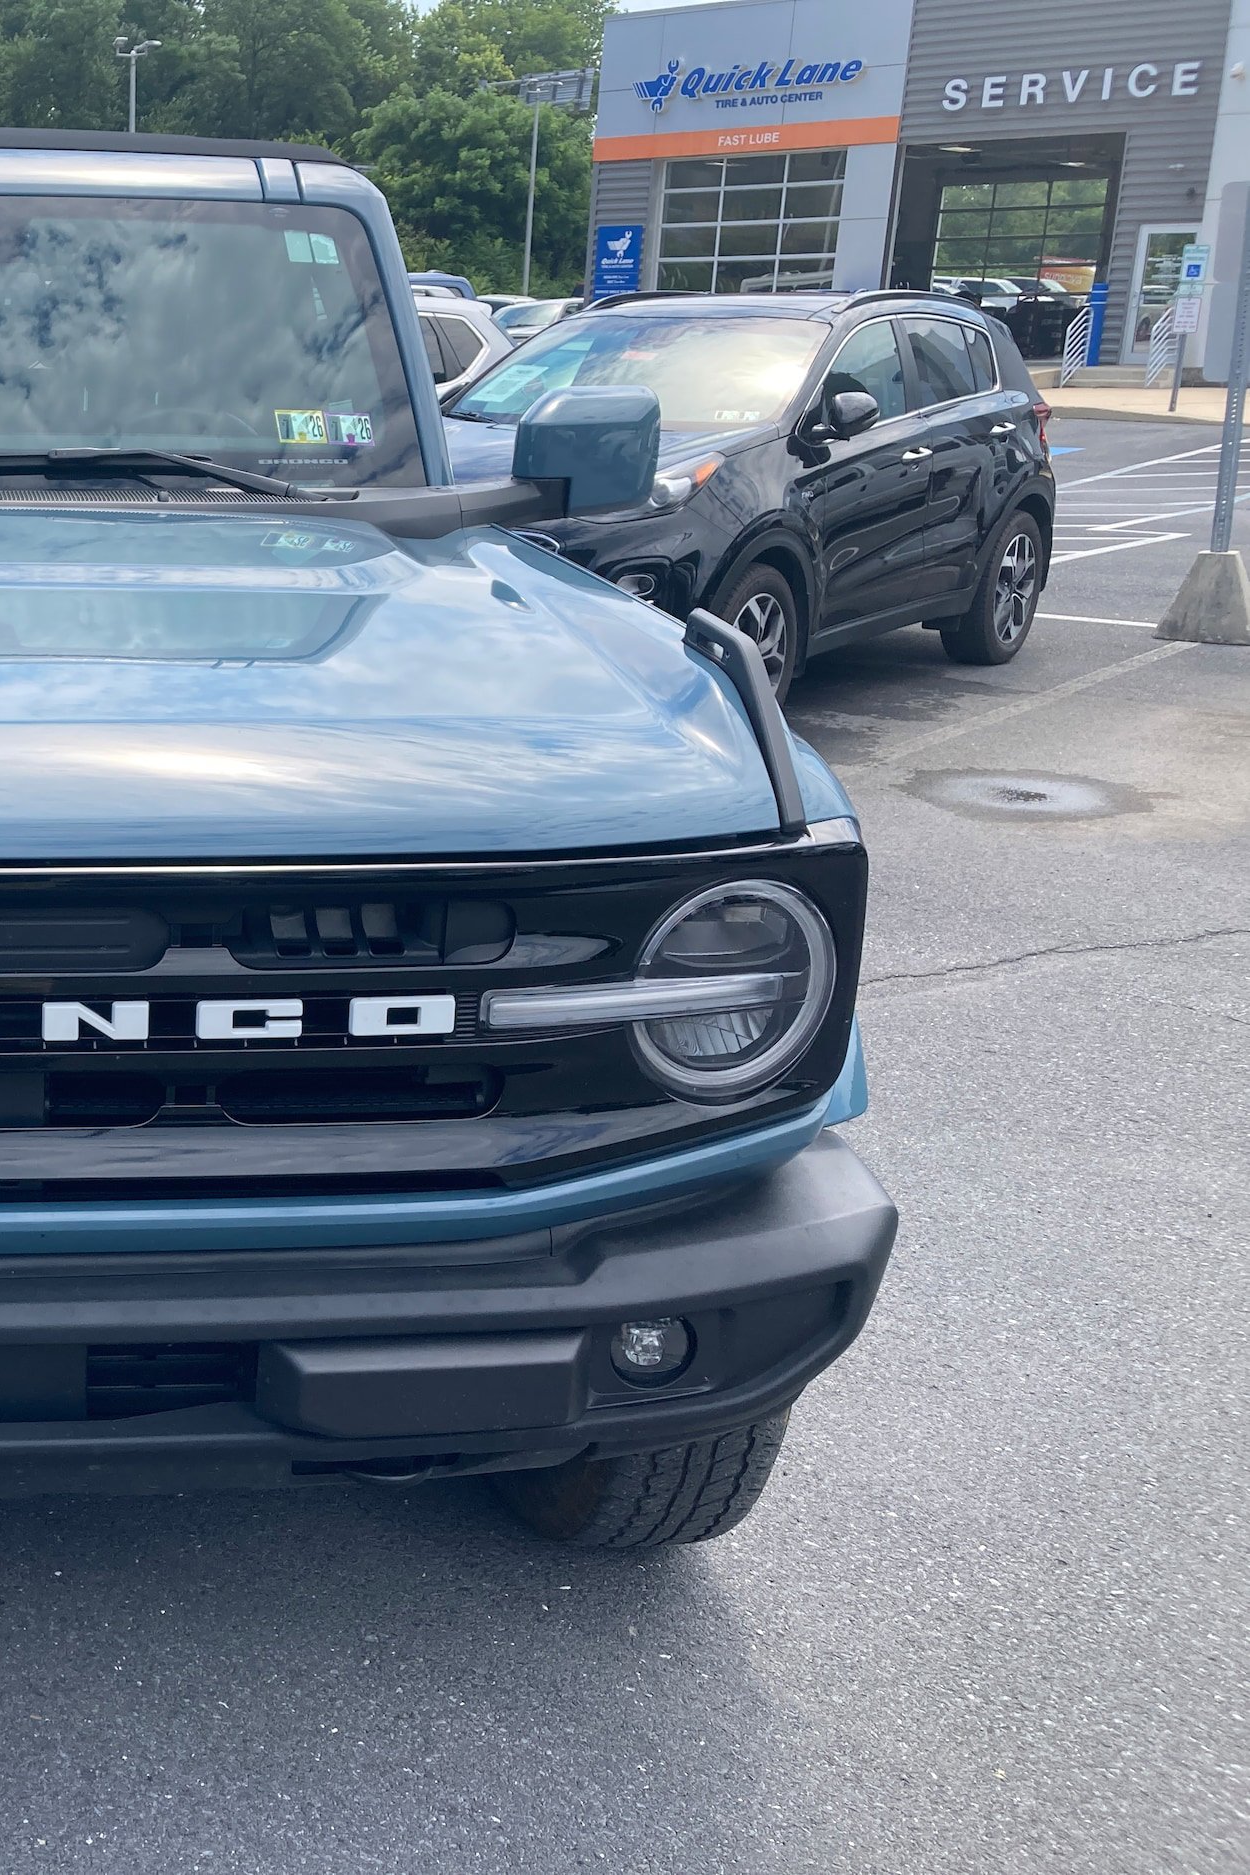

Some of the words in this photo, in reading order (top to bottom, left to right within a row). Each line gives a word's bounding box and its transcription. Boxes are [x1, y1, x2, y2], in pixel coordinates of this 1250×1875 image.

[680, 61, 774, 98] Quick
[775, 59, 863, 88] Lane
[941, 60, 1202, 111] SERVICE
[715, 99, 739, 109] TIRE
[740, 98, 748, 107] &
[750, 95, 779, 106] AUTO
[780, 91, 823, 104] CENTER
[718, 134, 748, 147] FAST
[749, 132, 781, 145] LUBE
[310, 416, 324, 437] 26
[358, 418, 372, 439] 26
